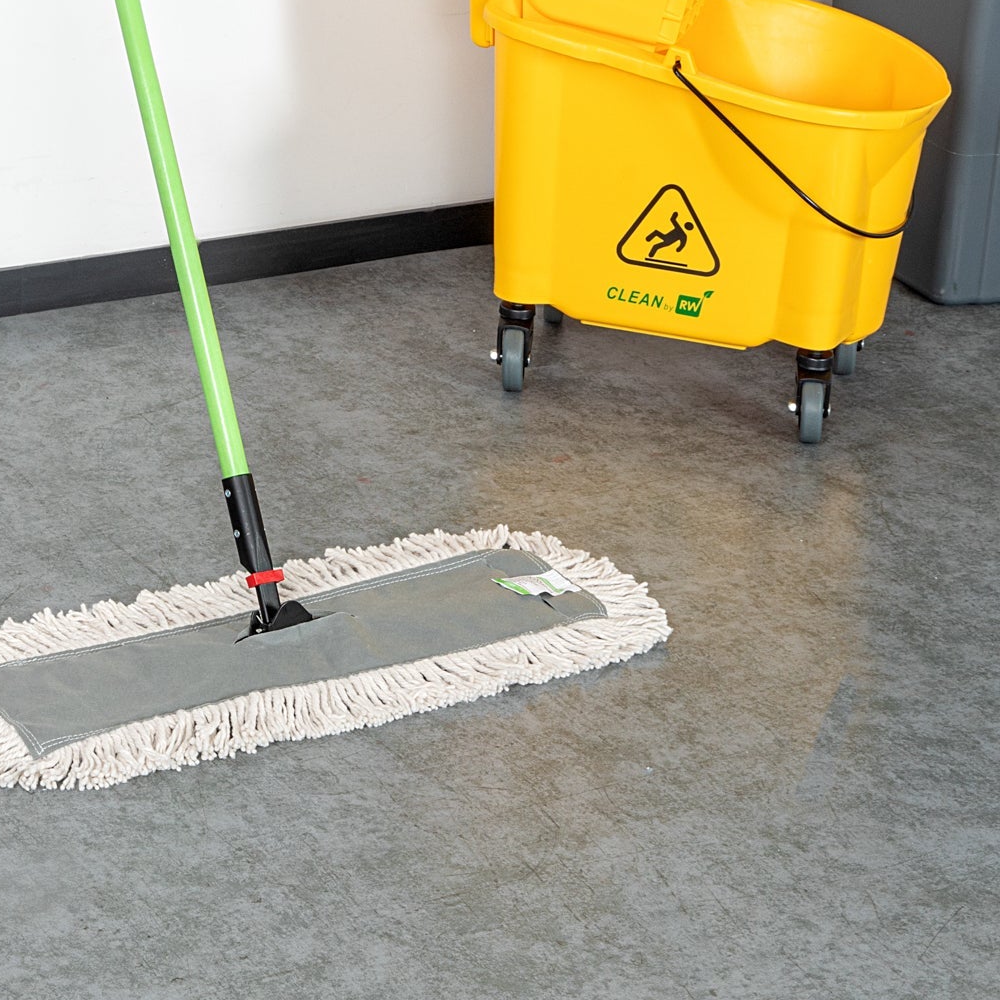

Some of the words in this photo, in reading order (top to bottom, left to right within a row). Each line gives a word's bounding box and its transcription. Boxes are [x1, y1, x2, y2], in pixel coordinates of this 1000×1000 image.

[607, 286, 664, 308] CLEAN
[664, 304, 674, 312] by
[679, 300, 701, 312] RW
